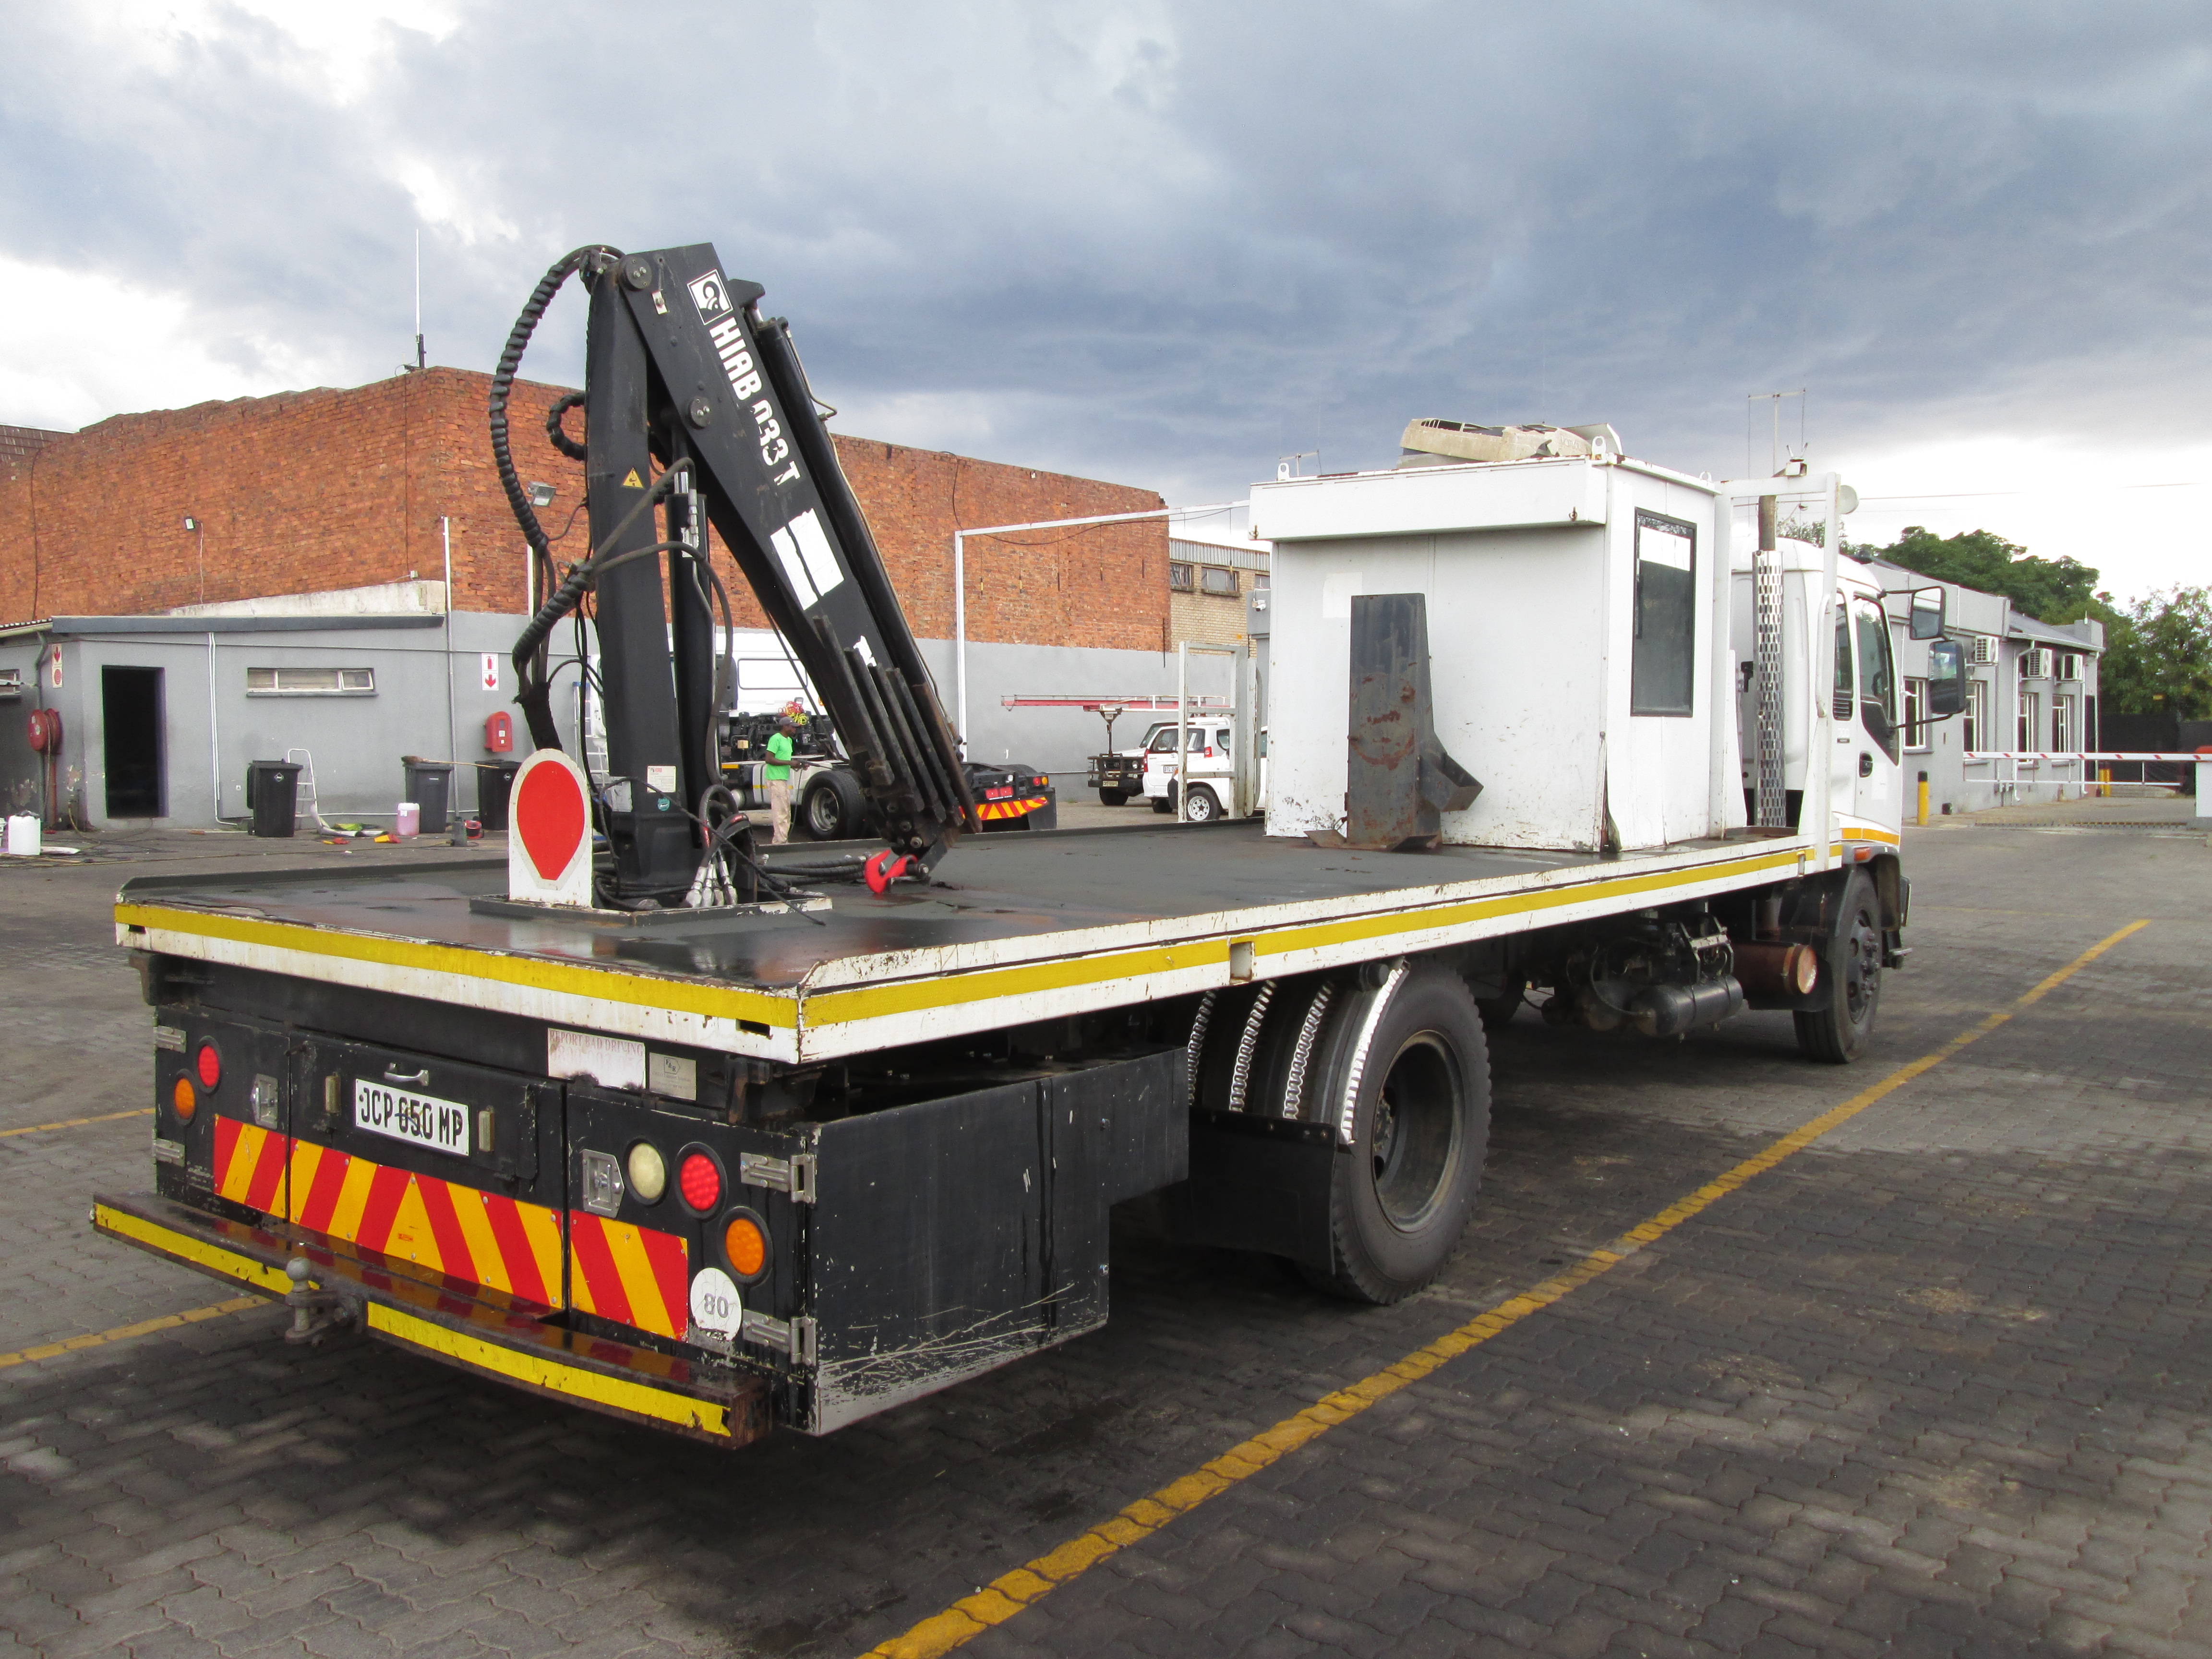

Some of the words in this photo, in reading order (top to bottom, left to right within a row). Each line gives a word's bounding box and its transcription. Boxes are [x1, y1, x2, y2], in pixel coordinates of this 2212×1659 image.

[709, 317, 762, 400] HIAB
[550, 1030, 583, 1046] REPORT
[585, 1036, 602, 1049] BAD
[605, 1039, 643, 1057] DRIVING
[361, 1087, 393, 1128] JCP
[439, 1106, 463, 1147] MP
[704, 1293, 729, 1318] 80
